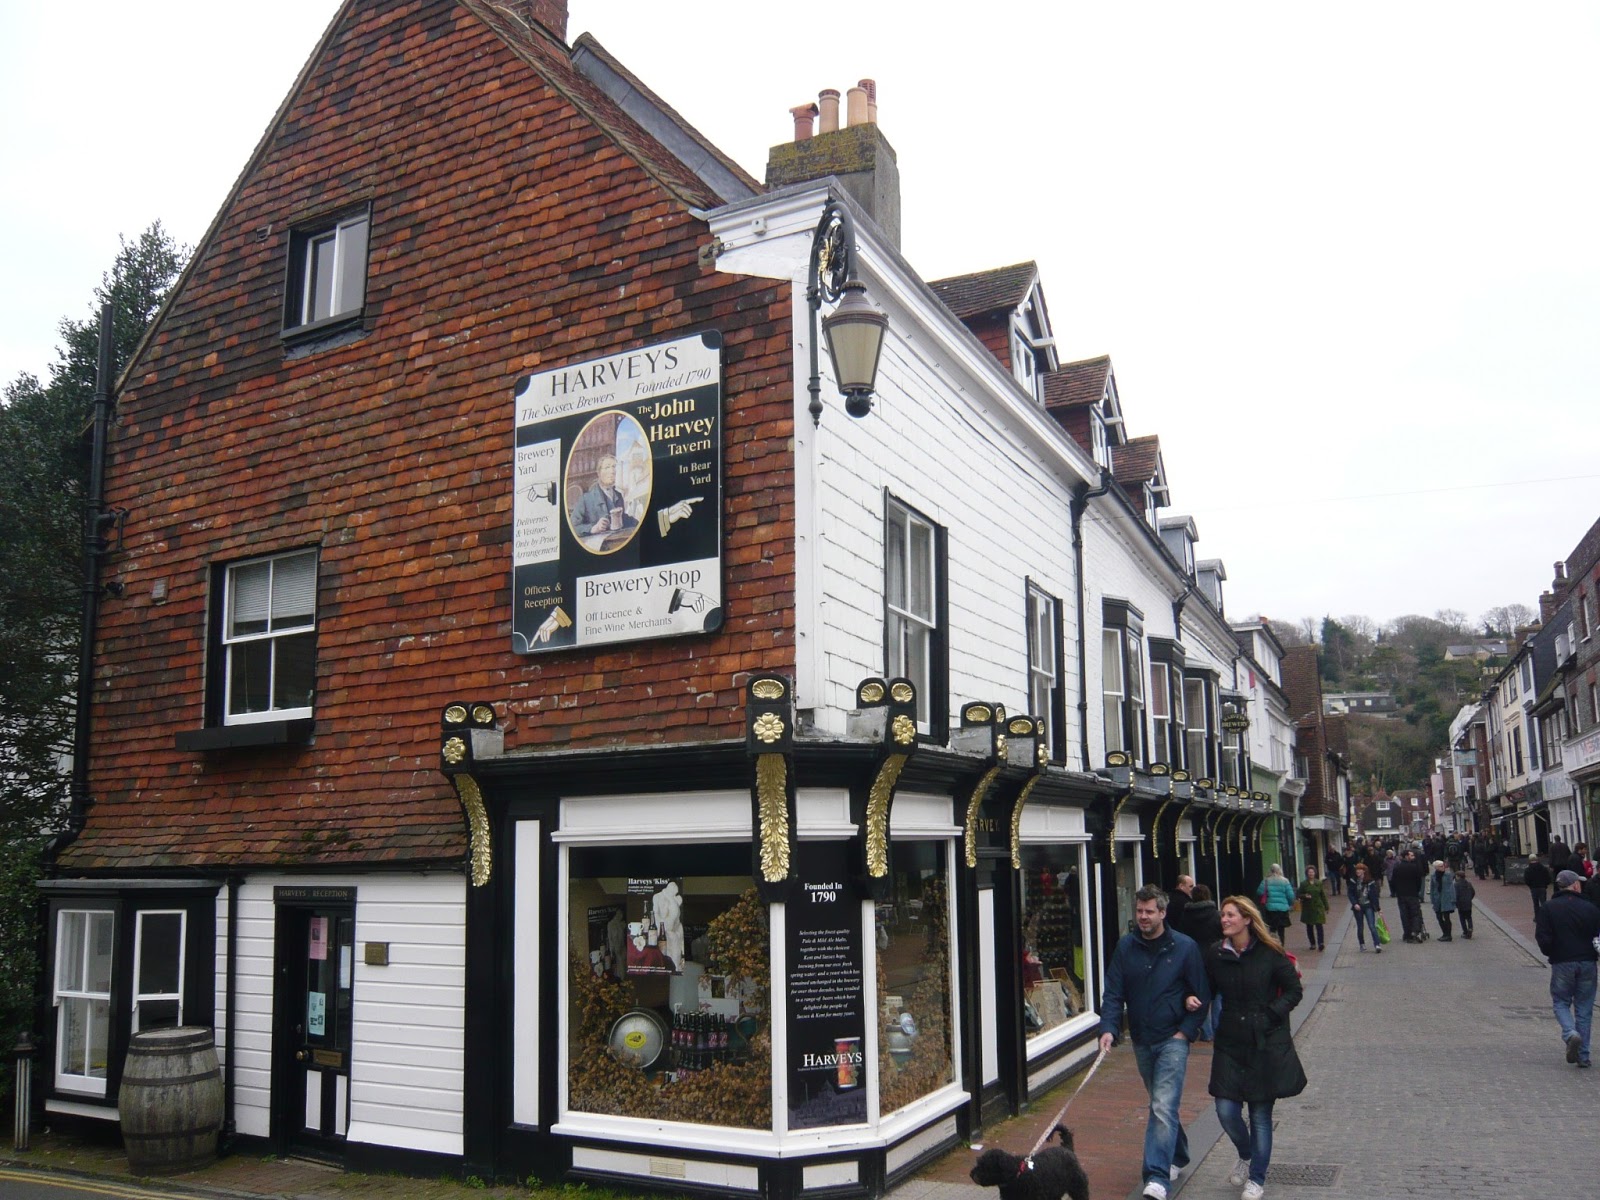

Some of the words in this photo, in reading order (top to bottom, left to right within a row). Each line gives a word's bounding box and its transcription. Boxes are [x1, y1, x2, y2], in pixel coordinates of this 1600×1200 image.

[552, 346, 678, 397] HARVEYS
[522, 409, 538, 421] The
[541, 402, 573, 417] Sussex
[577, 392, 615, 409] Brewers
[635, 377, 683, 396] Founded
[685, 367, 712, 384] 1790
[637, 405, 651, 415] The
[650, 398, 695, 420] John
[650, 416, 715, 442] Harvey
[517, 446, 556, 462] Brewery
[668, 439, 711, 456] Tavern
[517, 463, 538, 476] Yard
[679, 465, 688, 474] In
[691, 461, 712, 472] Bear
[690, 475, 712, 486] Yard
[516, 515, 549, 527] Deliveries
[515, 530, 521, 538] &
[523, 527, 547, 536] Visitors
[515, 540, 529, 549] Only
[530, 538, 539, 548] by
[539, 536, 557, 545] Prior
[516, 545, 559, 559] Arrangement
[524, 584, 551, 597] Offices
[554, 582, 562, 592] &
[585, 576, 653, 598] Brewery
[658, 567, 702, 589] Shop
[524, 595, 563, 611] Reception
[585, 611, 598, 622] Off
[600, 608, 633, 621] Licence
[635, 606, 643, 615] &
[585, 625, 602, 636] Fine
[604, 622, 626, 633] Wine
[628, 617, 673, 631] Merchants
[628, 878, 653, 886] Harveys
[804, 882, 833, 891] Founded
[835, 882, 843, 890] In
[279, 889, 306, 897] HARVEYS
[312, 889, 348, 898] RECEPTION
[811, 891, 836, 903] 1790
[803, 1051, 863, 1067] HARVEYS
